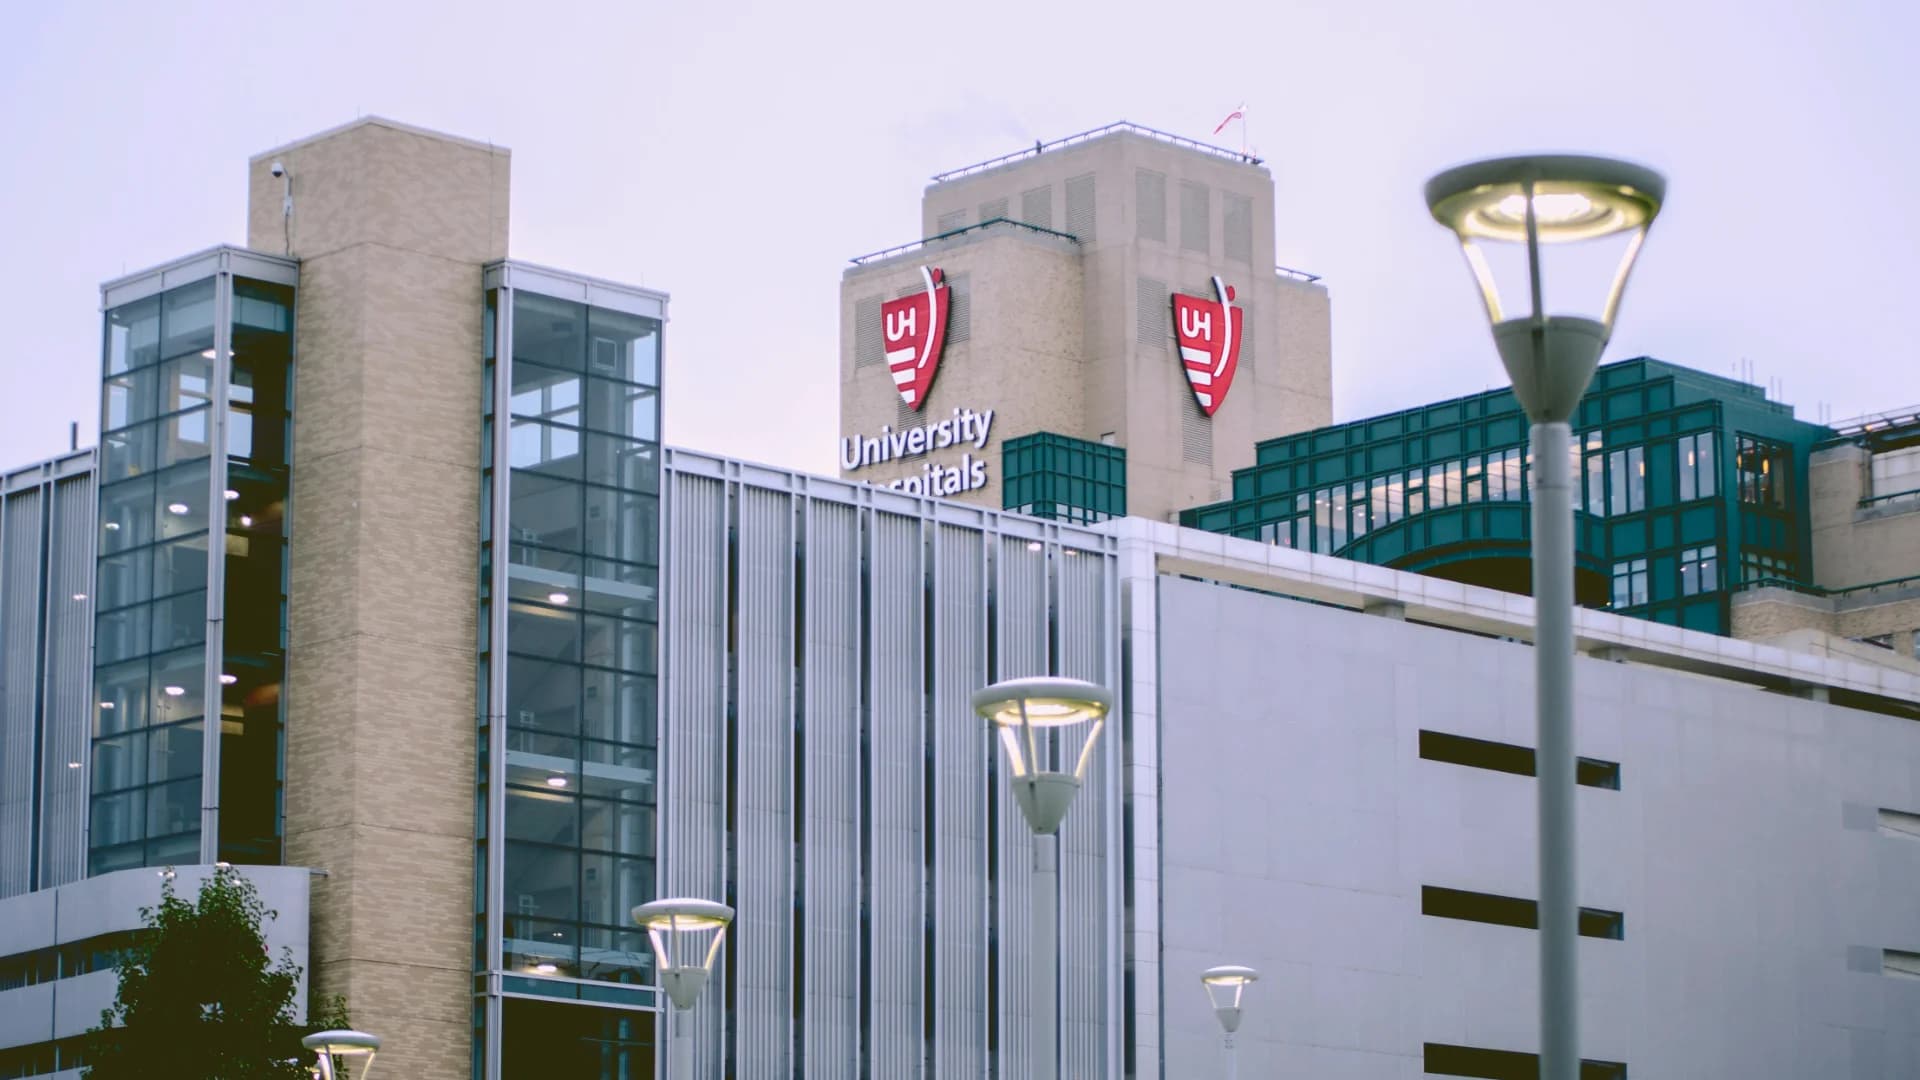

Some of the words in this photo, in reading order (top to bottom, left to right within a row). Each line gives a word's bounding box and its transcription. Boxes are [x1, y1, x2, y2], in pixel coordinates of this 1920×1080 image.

[886, 307, 916, 341] UH
[1181, 306, 1211, 341] UH
[841, 408, 993, 470] University
[861, 453, 987, 496] pitals
